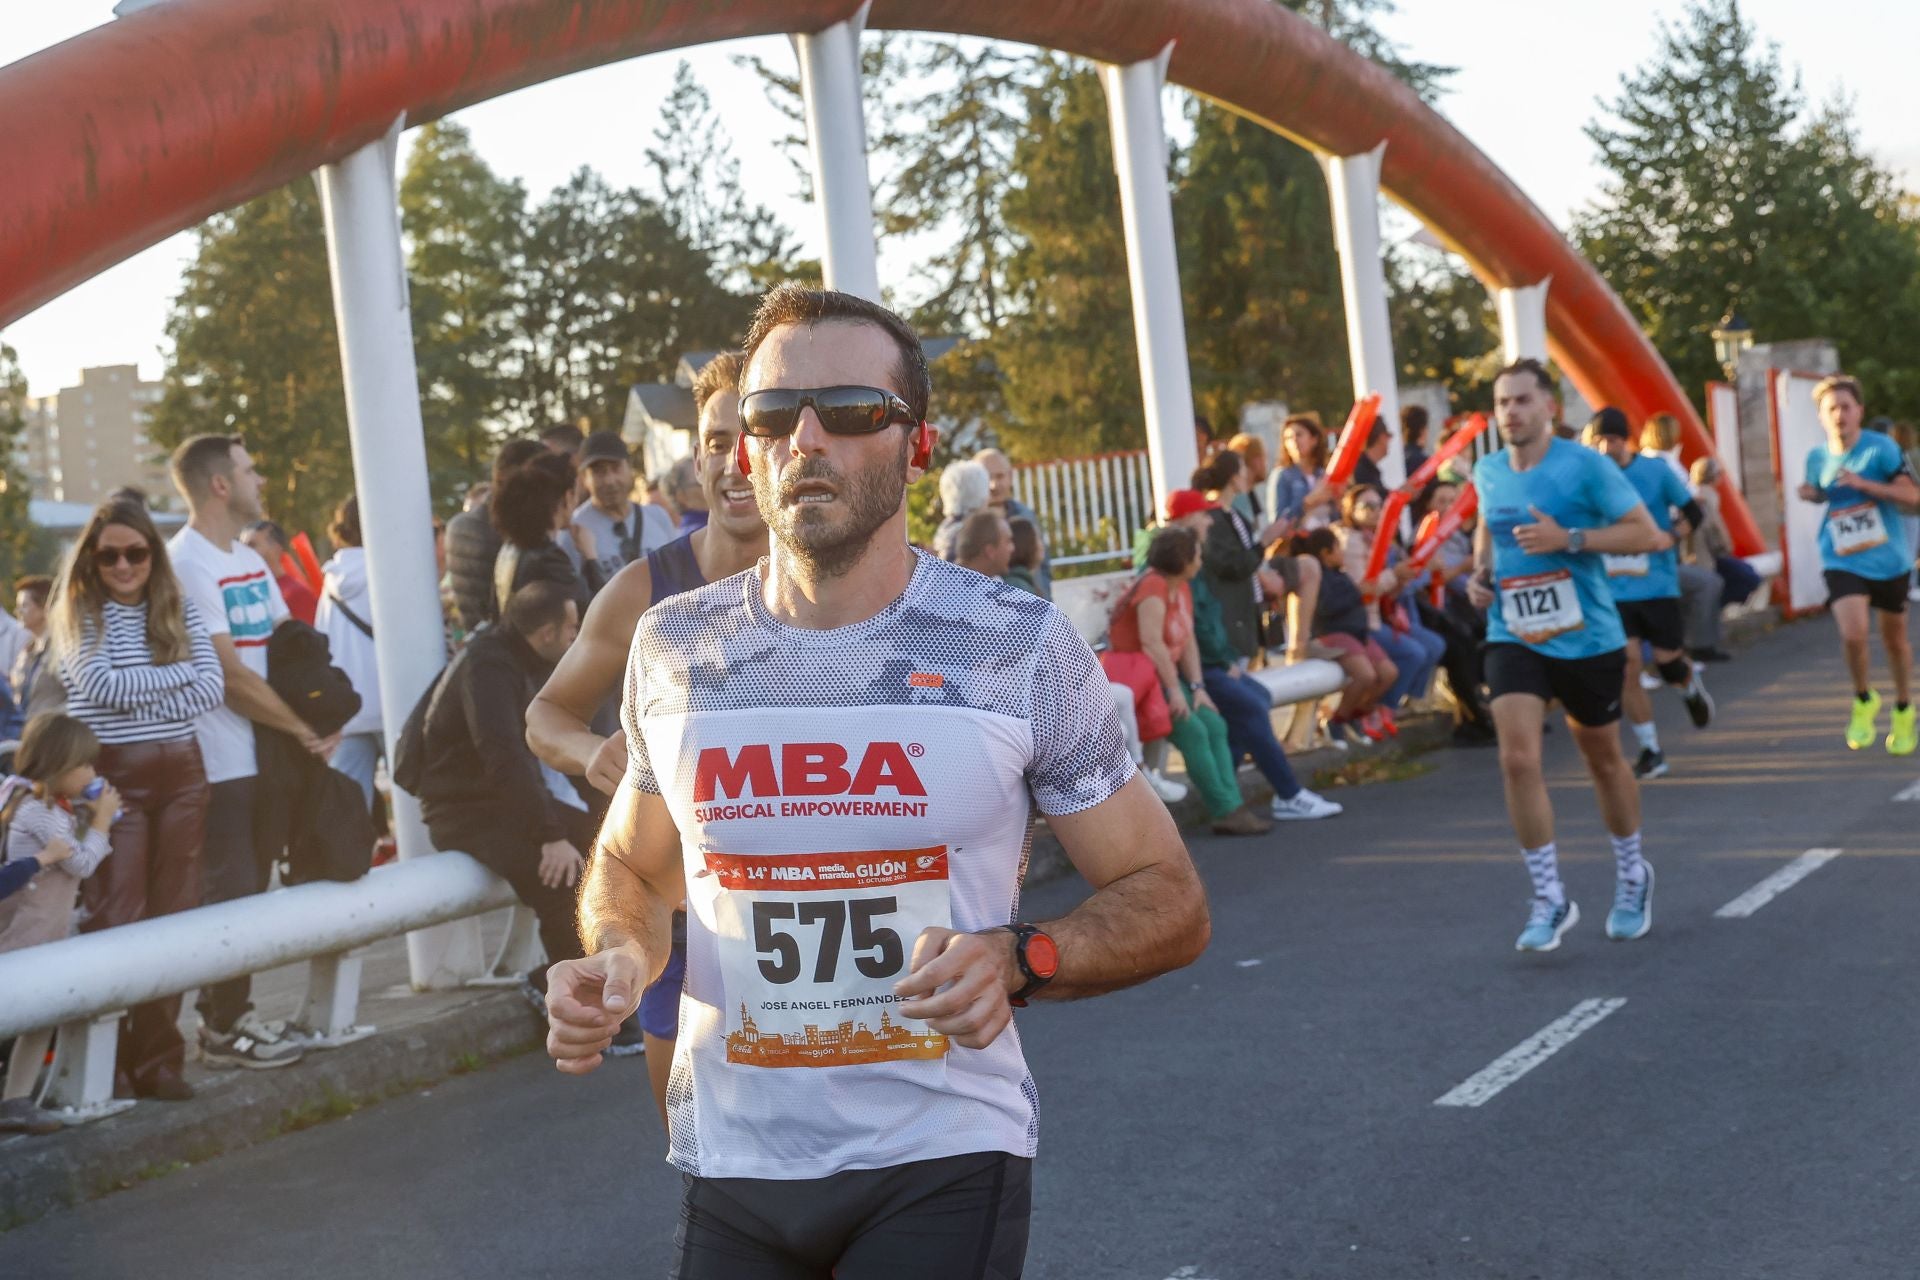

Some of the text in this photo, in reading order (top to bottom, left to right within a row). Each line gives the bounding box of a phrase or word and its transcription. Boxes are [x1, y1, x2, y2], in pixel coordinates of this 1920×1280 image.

[1512, 586, 1560, 617] 1121
[695, 801, 928, 823] SURGICAL EMPOWERMENT
[771, 866, 816, 881] MBA
[818, 863, 845, 872] media
[819, 870, 855, 880] maratón
[856, 859, 907, 877] GIJÓN
[866, 876, 893, 884] OCTUBRE
[752, 896, 904, 984] 575
[760, 1001, 788, 1010] JOSE
[791, 1000, 830, 1010] ANGEL
